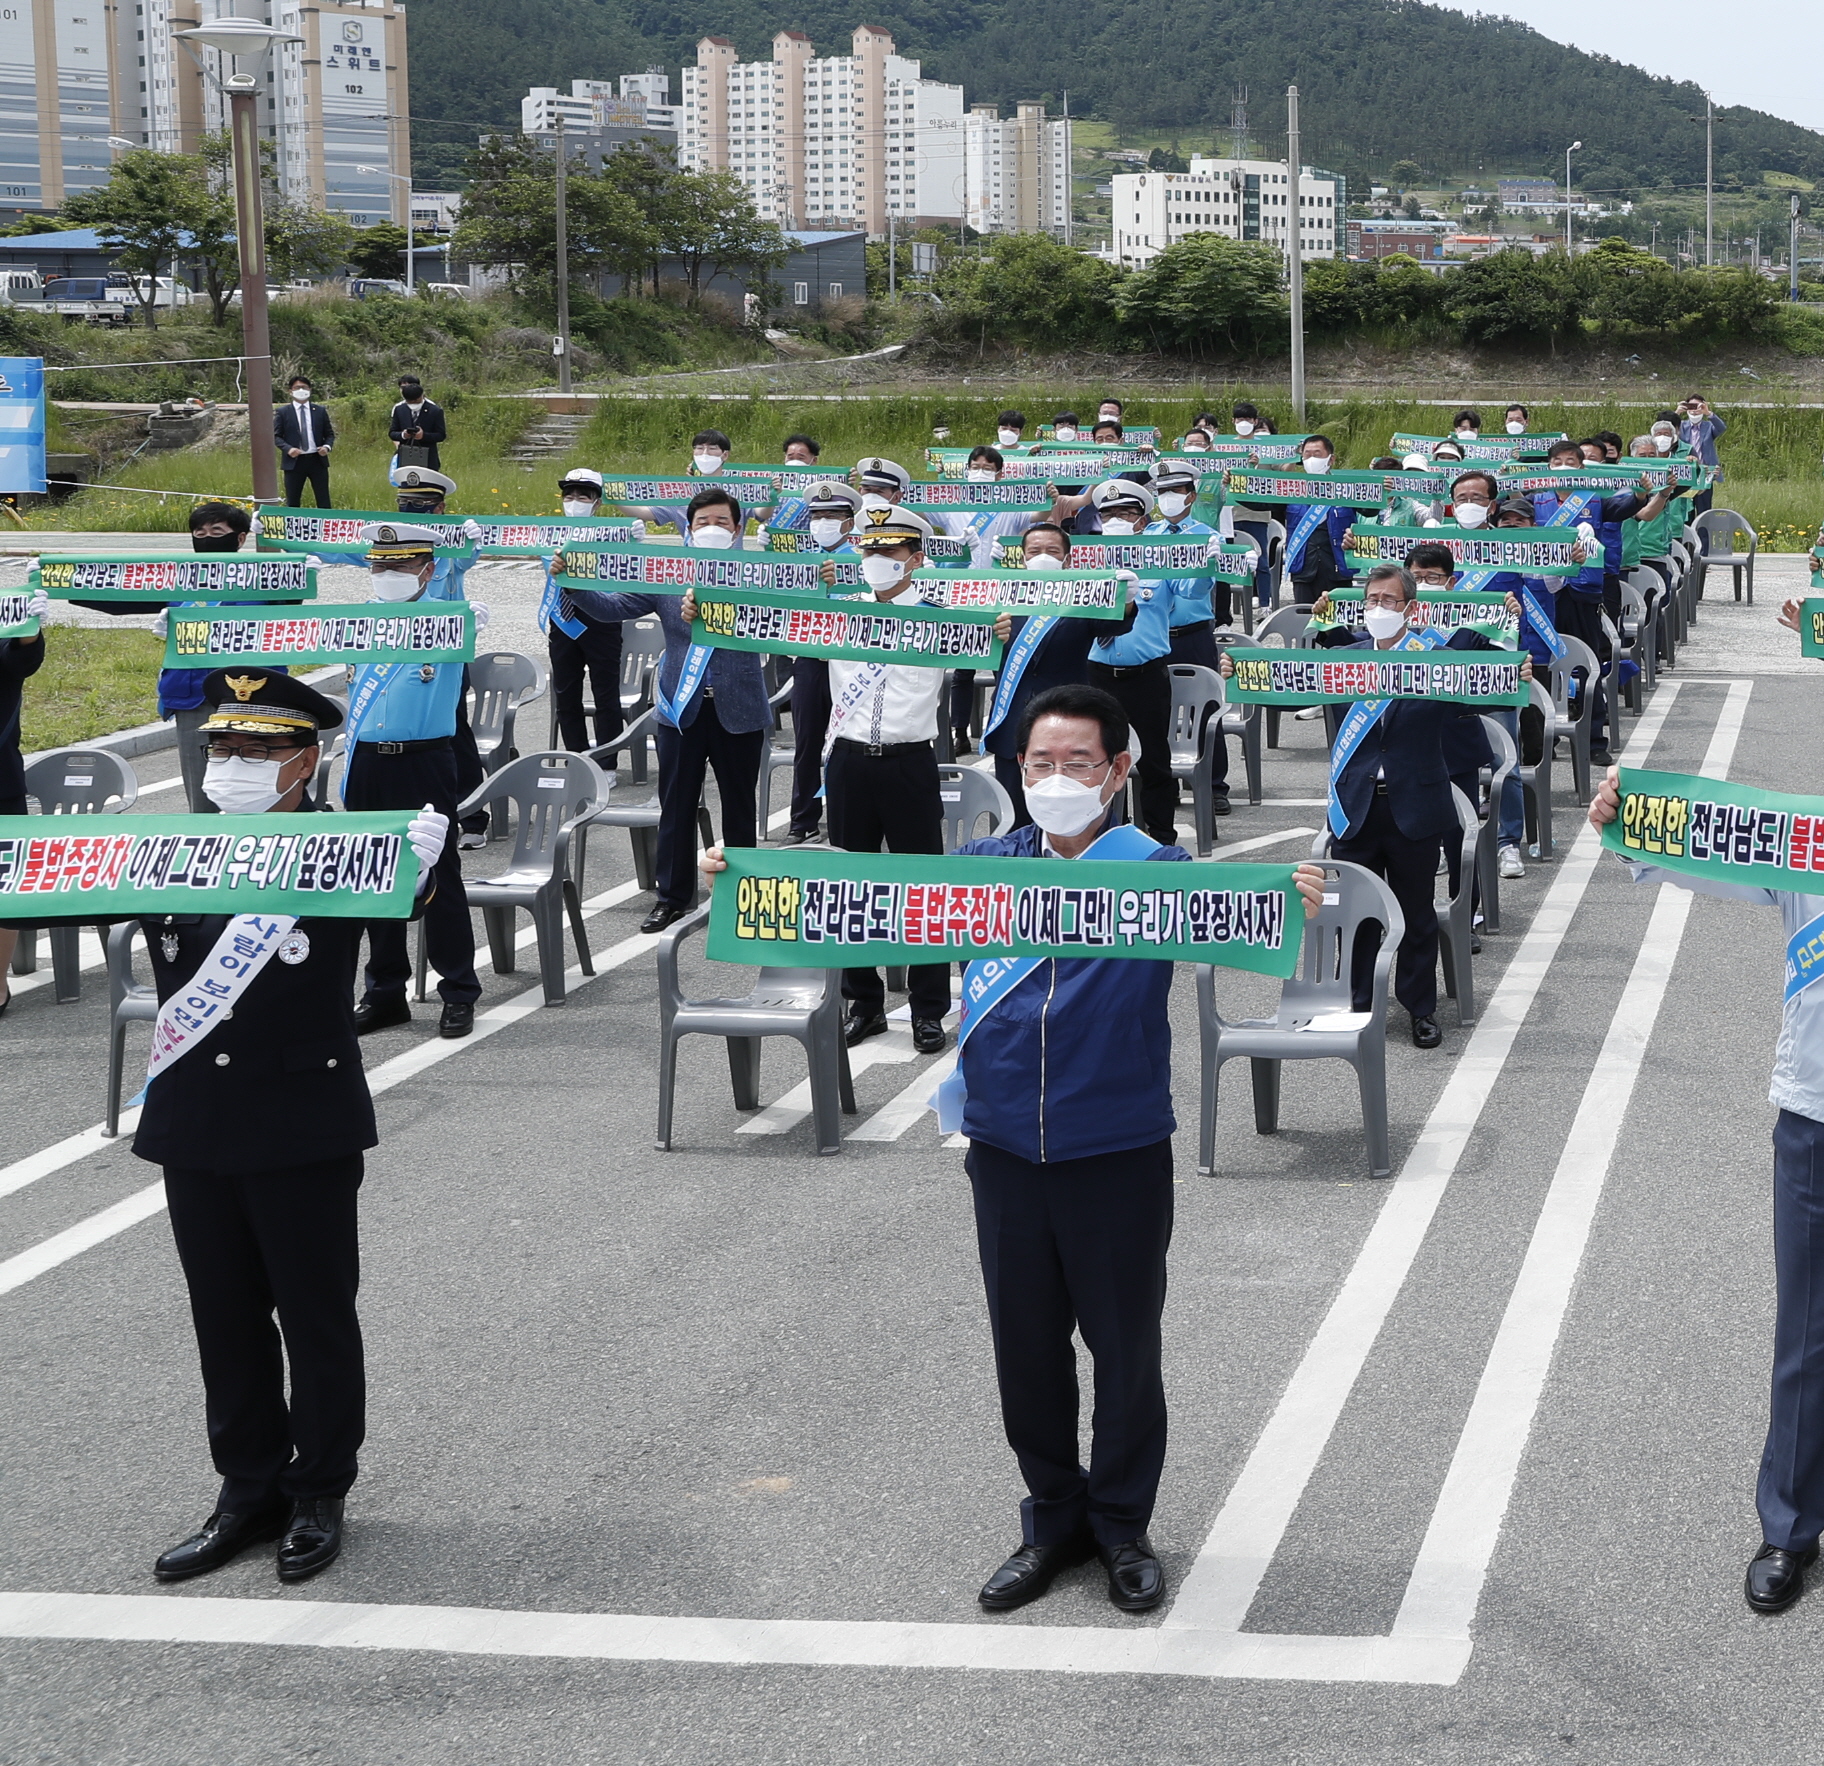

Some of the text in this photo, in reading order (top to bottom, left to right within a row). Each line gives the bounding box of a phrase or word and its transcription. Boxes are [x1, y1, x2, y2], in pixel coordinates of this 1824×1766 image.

[326, 56, 381, 71] 스위트
[345, 84, 363, 94] 102
[6, 187, 27, 197] 101
[1054, 461, 1073, 478] 우리가
[604, 482, 692, 500] 안전한 전라남도! 불법주정차
[925, 485, 1015, 504] 불법주정차 이제그만! 우리가
[1248, 476, 1382, 502] 전라남도! 불법주정차 이제그만! 우리가 앞장서자!
[1106, 545, 1170, 570] 이제그만! 우리가
[1464, 540, 1503, 565] 이제그만!
[1504, 541, 1532, 566] 우리가
[73, 562, 306, 591] 전라남도! 불법주정차 이제그만! 우리가 앞장서자!
[566, 552, 597, 579] 안전한
[598, 553, 642, 581] 전라남도!
[644, 556, 695, 585] 불법주정차
[697, 559, 741, 588] 이제그만!
[742, 562, 773, 589] 우리가
[774, 562, 819, 591] 앞장서자!
[951, 578, 1116, 608] 불법주정차 이제그만! 우리가 앞장서자!
[175, 615, 465, 655] 안전한 전라남도! 불법주정차 이제그만! 우리가 앞장서자!
[701, 601, 992, 656] 안전한 전라남도! 불법주정차 이제그만! 우리가 앞장서자!
[677, 647, 705, 701] 릴레이 캠페인
[841, 673, 871, 709] 보이면
[1236, 659, 1519, 697] 안전한 전라남도! 불법주정차 이제그만! 우리가 앞장서자!
[1338, 712, 1367, 748] 교통안전
[1621, 792, 1688, 856] 안전한
[1688, 801, 1786, 868] 전라남도!
[17, 835, 136, 893] 불법주정차
[127, 835, 230, 890] 이제그만!
[225, 834, 301, 891] 우리가
[299, 834, 400, 894] 앞장서자!
[734, 875, 1285, 950] 안전한 전라남도! 불법주정차 이제그만! 우리가 앞장서자!
[219, 916, 280, 978] 사람이
[174, 979, 232, 1032] 보이면
